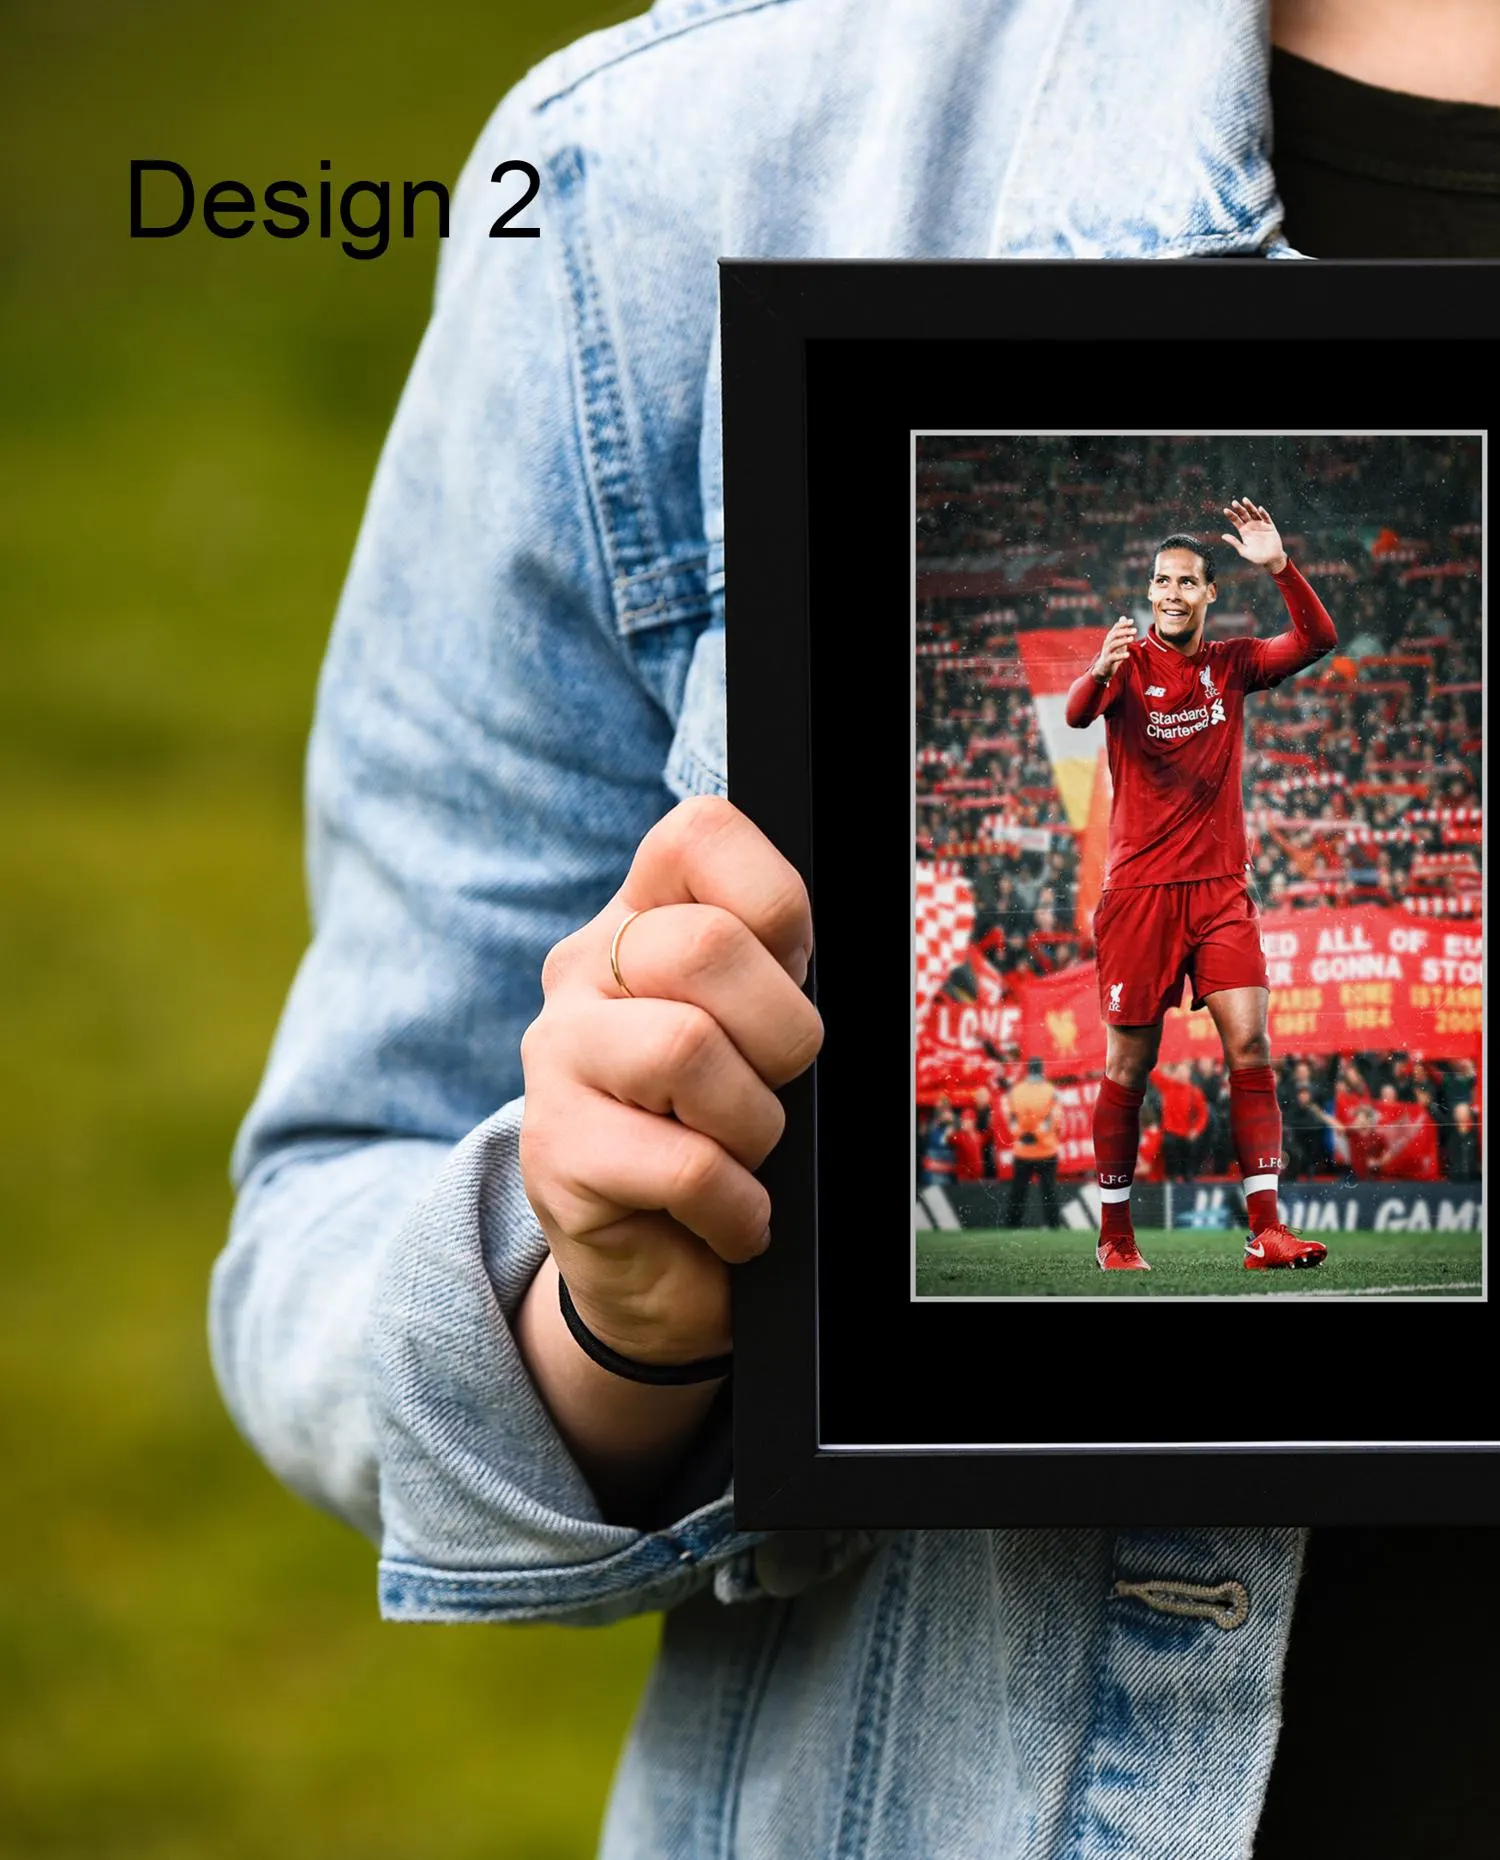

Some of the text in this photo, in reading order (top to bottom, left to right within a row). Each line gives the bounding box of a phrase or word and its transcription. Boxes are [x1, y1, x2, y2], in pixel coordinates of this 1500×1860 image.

[1146, 716, 1210, 739] Chartered
[1149, 705, 1209, 725] Standard
[1263, 932, 1299, 958] ED
[1316, 927, 1372, 951] ALL
[1389, 929, 1427, 952] OF
[1268, 955, 1482, 985] ER GONNA STO
[938, 1006, 1021, 1049] LOVE
